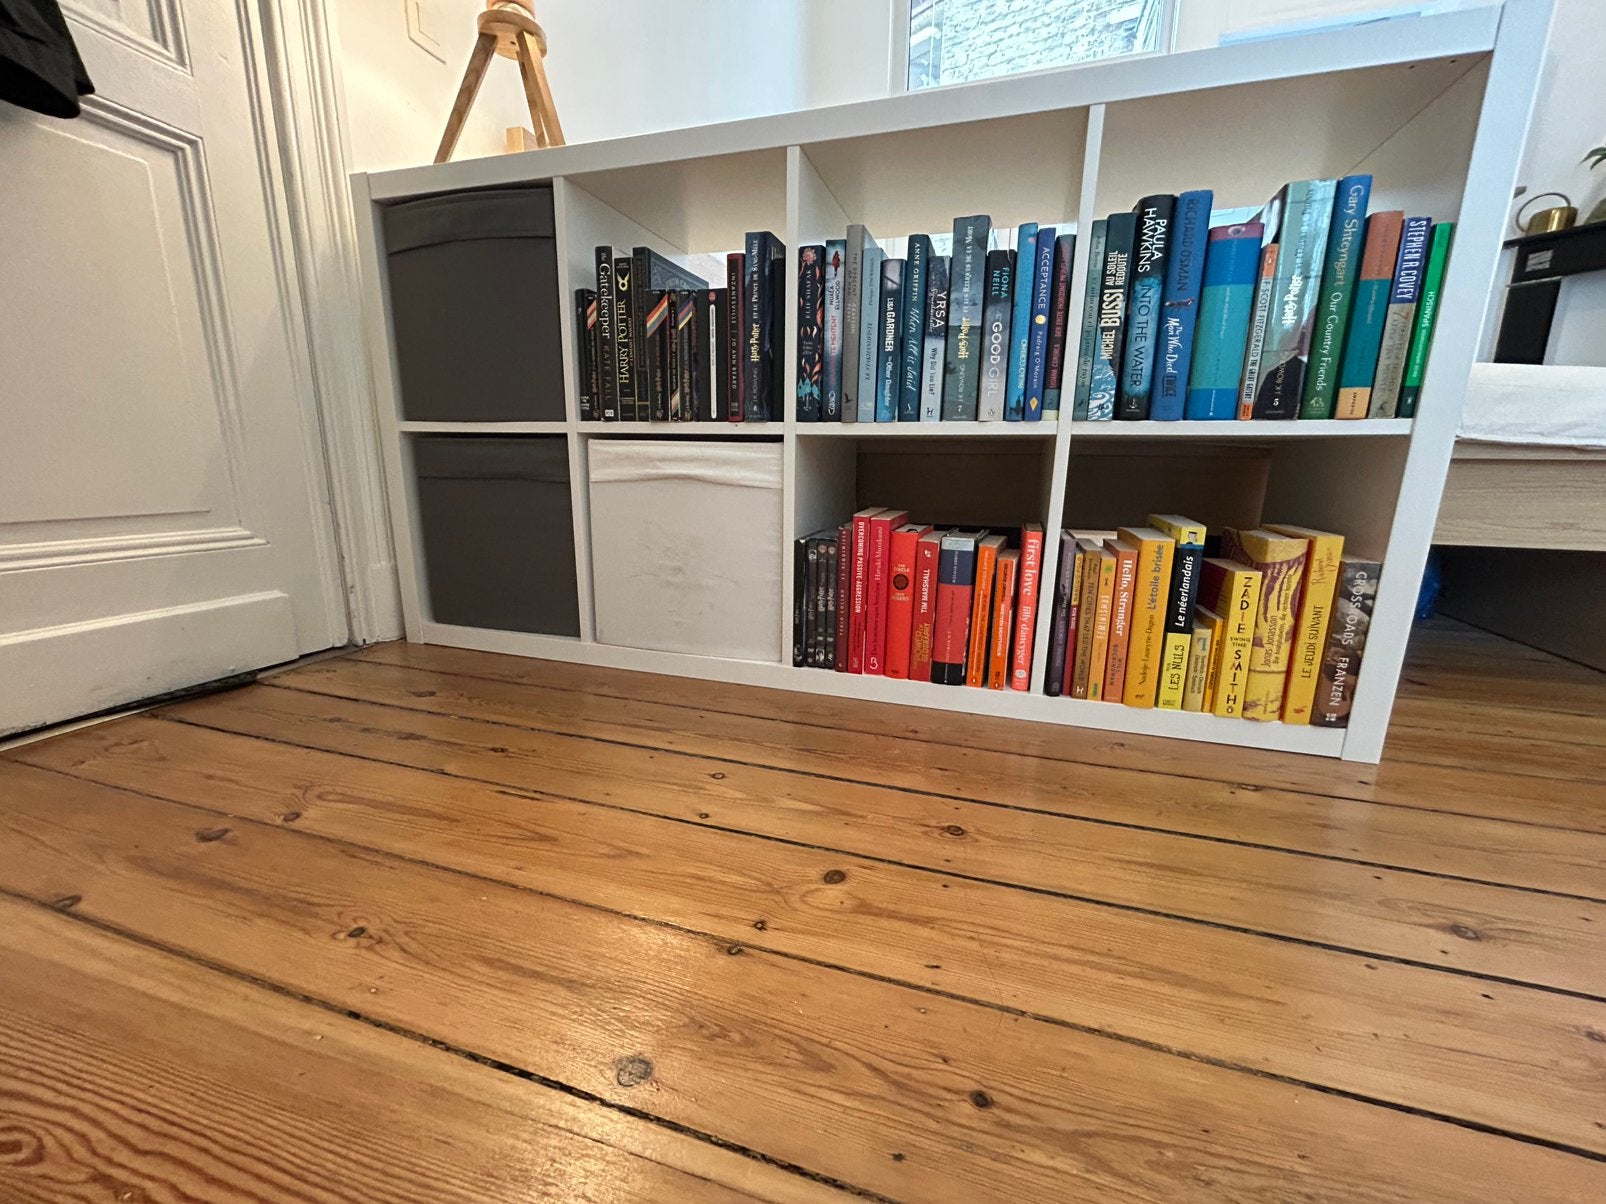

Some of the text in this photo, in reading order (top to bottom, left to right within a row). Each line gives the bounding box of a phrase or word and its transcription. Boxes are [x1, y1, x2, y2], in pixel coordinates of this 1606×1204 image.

[965, 226, 974, 244] MORT
[1137, 208, 1158, 273] HAWKINS
[1151, 219, 1167, 261] PAULA
[1176, 198, 1198, 291] RICHARD OSMAN
[911, 243, 921, 302] ANNE GRIFFIN
[963, 264, 973, 292] RELIQUES
[1037, 247, 1051, 310] ACCEPTANCE
[1106, 251, 1119, 286] AU SOLEIL
[1396, 220, 1427, 300] STEPHEN R. COVEY
[599, 263, 613, 339] Gatekeeper
[751, 282, 759, 303] PRINCE
[991, 270, 1001, 296] NEILL
[1000, 267, 1010, 299] FIONA
[1057, 283, 1066, 310] HORIZONT
[1258, 289, 1270, 313] SCOTT
[1281, 275, 1303, 325] Harry Potter
[1315, 185, 1363, 391] Gary Shteyngart Our Country Friends
[885, 298, 896, 352] LISA GARDNER
[935, 291, 948, 328] YRSA
[1100, 289, 1124, 327] BUSSI
[1421, 291, 1435, 328] SPANISCH
[617, 298, 630, 383] HARRY POTTER
[750, 323, 760, 363] Harry Potter
[830, 315, 838, 346] MENTENT
[905, 308, 920, 391] When All is Said
[957, 315, 970, 360] Harry Potter
[1033, 331, 1043, 356] Padraig
[1054, 326, 1062, 338] DER
[1100, 330, 1115, 361] MICHEL
[1129, 284, 1154, 387] INTO THE WATER
[1250, 315, 1267, 358] FITZGERALD
[602, 346, 613, 401] KATE FALL
[929, 348, 938, 360] Why
[987, 321, 1003, 397] GOOD GIRL
[1018, 339, 1027, 367] COELHO
[1164, 317, 1183, 398] The Man Who Died TWICE
[1249, 359, 1259, 367] THE
[884, 362, 894, 407] Other Daughter
[928, 384, 936, 396] Lie?
[1246, 368, 1257, 382] GREAT
[855, 521, 865, 613] OVERCOMING PASSIVE-AGGRESSION
[874, 527, 883, 581] Haruki Murakami
[1023, 539, 1039, 596] first love
[920, 568, 931, 613] TIM MARSHALL
[1087, 582, 1095, 593] TEN
[1115, 559, 1133, 637] Hello, Stranger
[1147, 544, 1163, 610] L'étoile brisée
[1175, 556, 1194, 627] Le néerlandais
[1085, 596, 1093, 615] CITIES
[1096, 595, 1110, 640] FEMINISMOS
[1237, 577, 1253, 634] ZADIE
[1282, 592, 1290, 613] rechnen
[913, 623, 931, 662] POWER GEOGRAPHY
[1016, 624, 1030, 665] dancyger
[1084, 617, 1092, 632] THAT
[1261, 615, 1277, 668] Jonas Jonasson
[1078, 658, 1088, 681] WORLD
[1109, 645, 1119, 687] BUCKINGHAM
[1170, 644, 1184, 670] NULS
[1226, 649, 1242, 705] SMITH
[1301, 669, 1311, 679] LE
[1168, 673, 1180, 691] LES
[1328, 657, 1350, 706] FRANZEN
